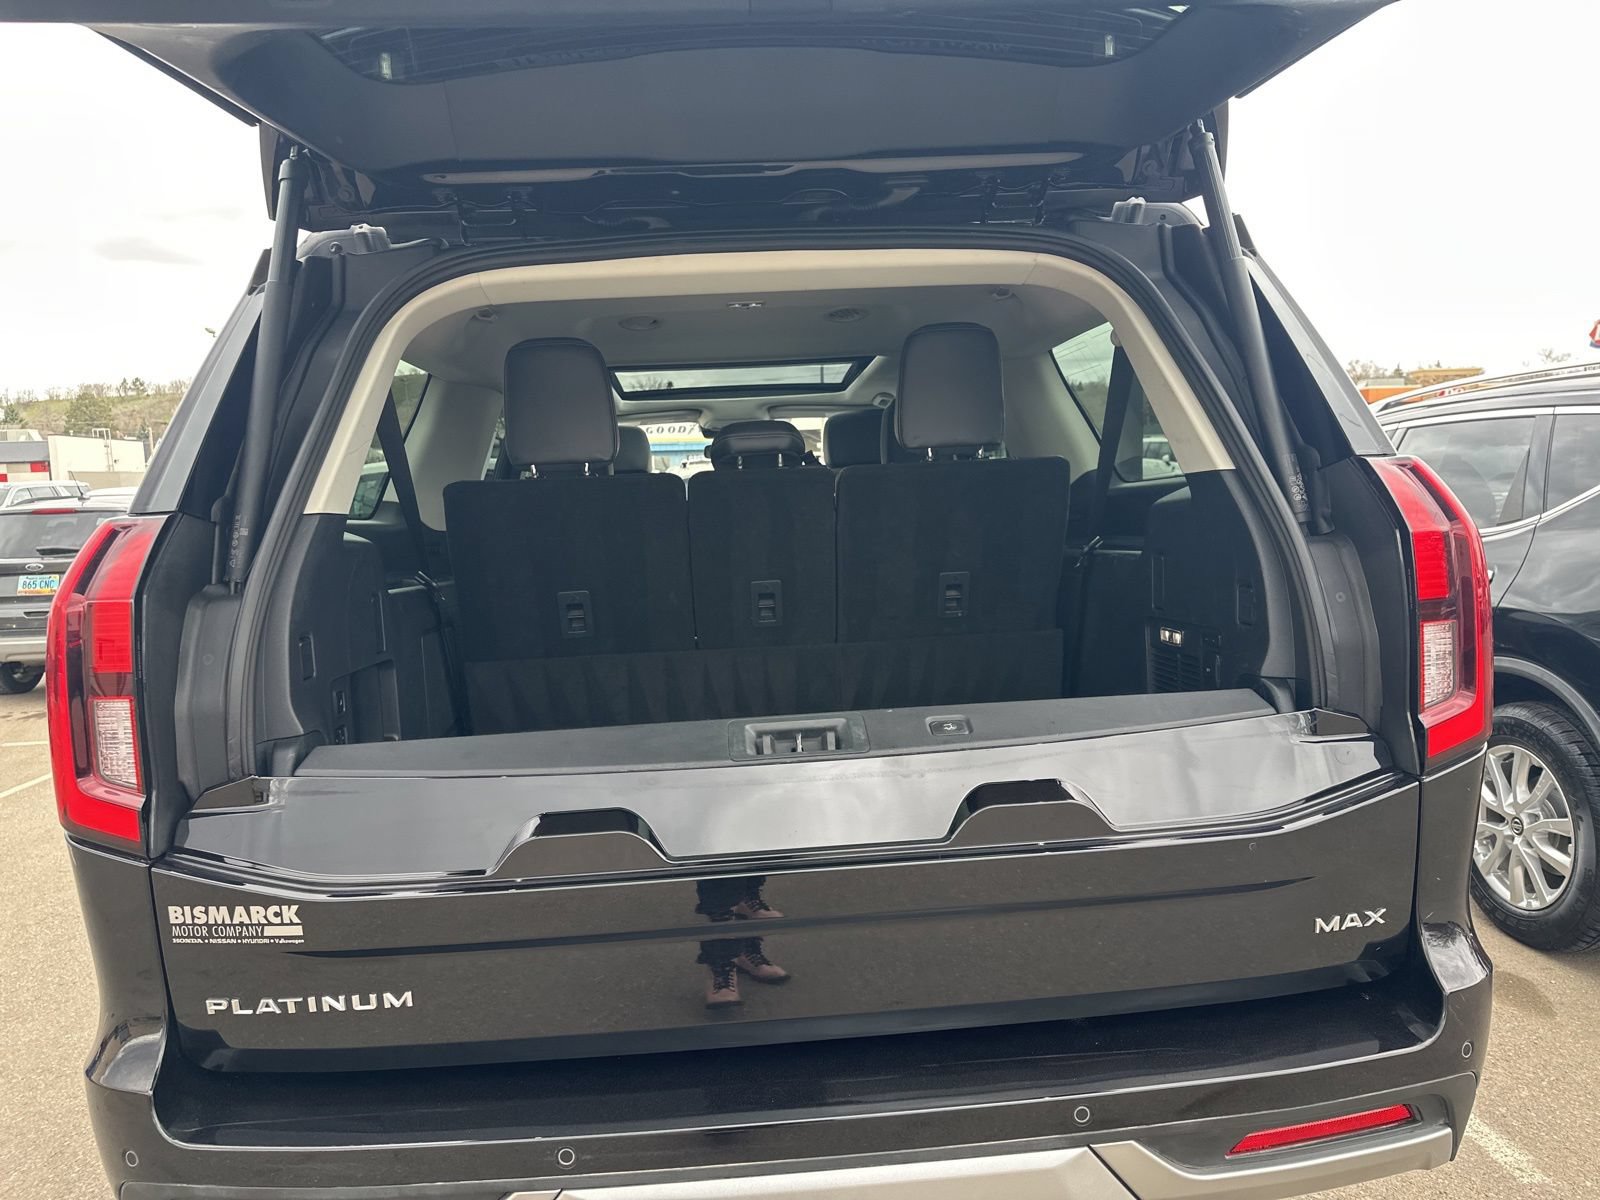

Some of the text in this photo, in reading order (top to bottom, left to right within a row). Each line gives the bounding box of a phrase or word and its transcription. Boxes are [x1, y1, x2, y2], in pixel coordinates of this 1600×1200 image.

[645, 425, 701, 434] GOOD
[22, 580, 54, 589] 865 CNC
[168, 905, 301, 924] BISMARCK
[1314, 907, 1387, 934] MAX
[172, 925, 263, 937] MOTOR COMPANY
[205, 991, 413, 1015] PLATINUM
